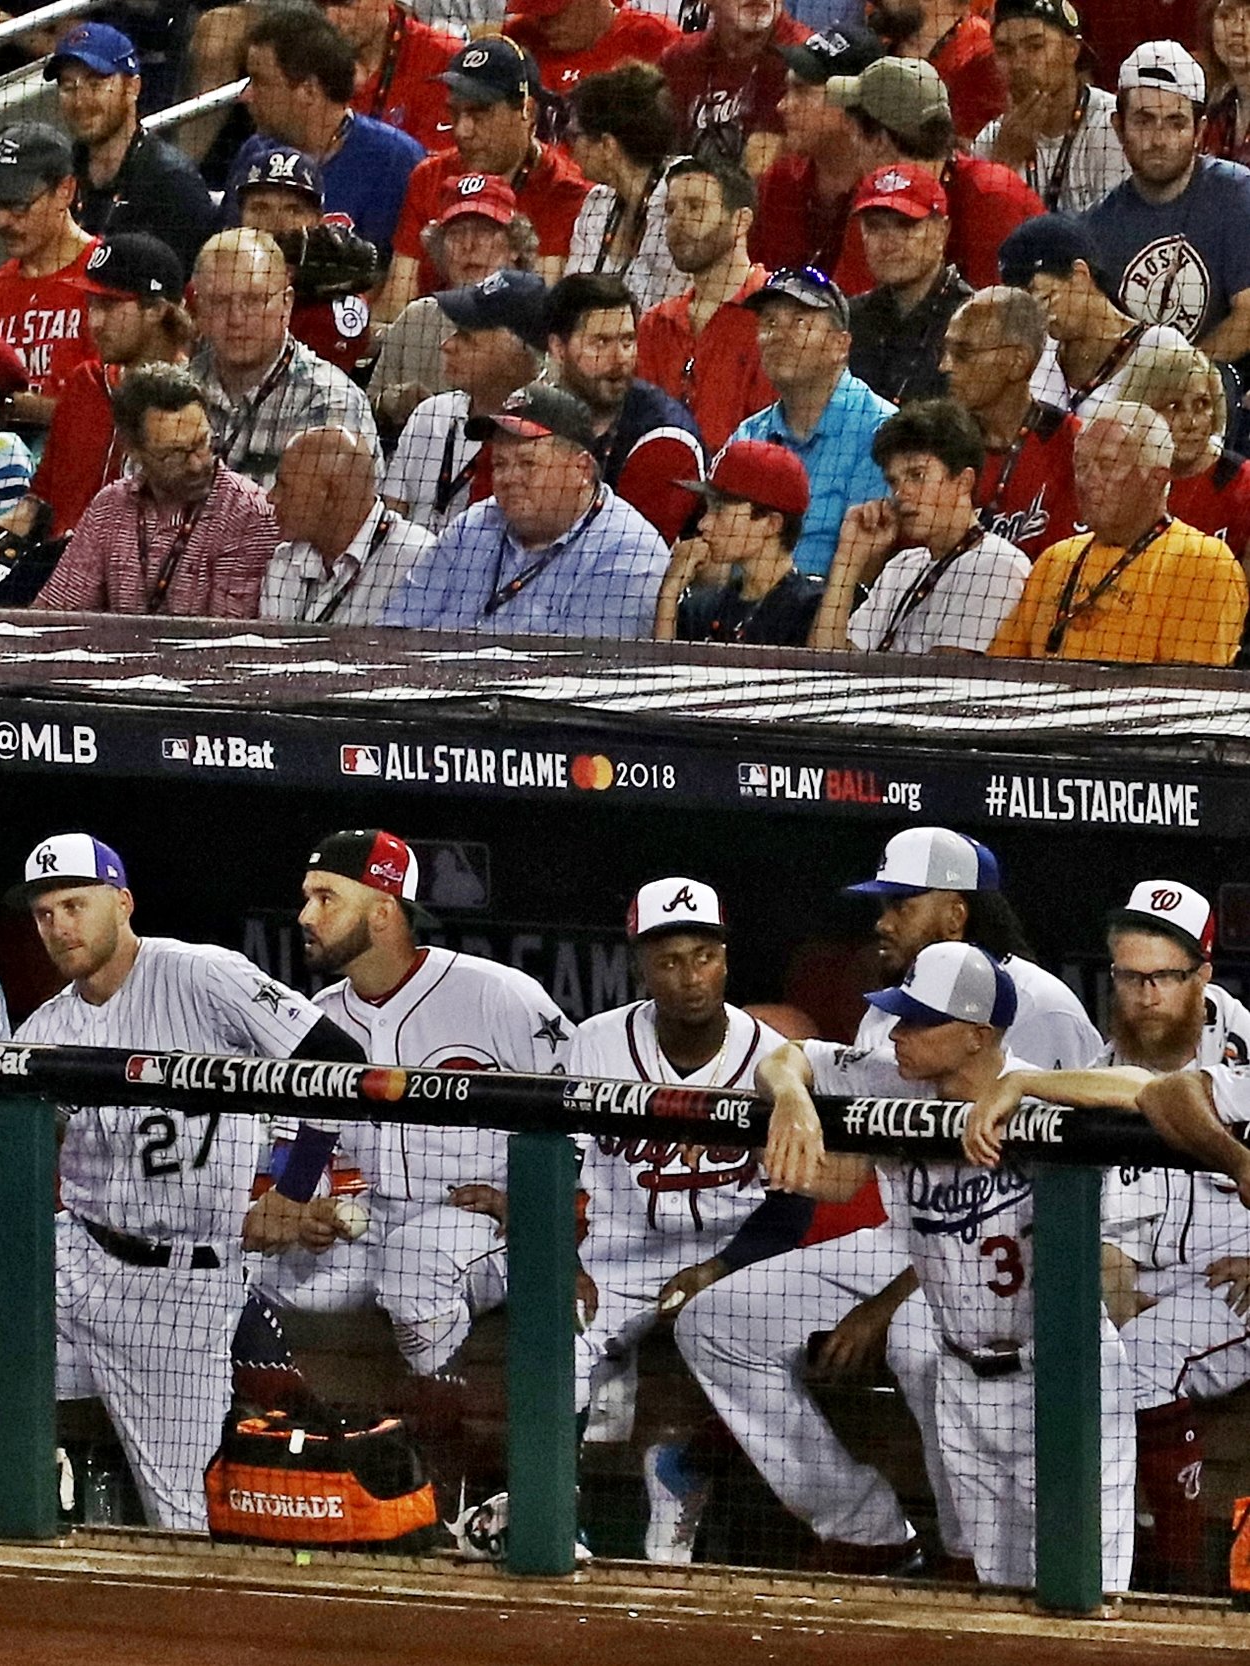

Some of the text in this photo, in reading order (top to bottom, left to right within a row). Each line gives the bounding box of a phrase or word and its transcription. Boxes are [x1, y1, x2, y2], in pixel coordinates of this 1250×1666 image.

[22, 308, 82, 345] STAR
[192, 735, 276, 770] At Bat
[384, 742, 676, 789] ALL STAR GAME 2018
[984, 774, 1200, 827] #ALLSTARGAME
[662, 885, 698, 913] A
[170, 1054, 470, 1101] ALL STAR GAME 2018
[138, 1110, 221, 1178] 27
[979, 1223, 1033, 1298] 3
[228, 1487, 345, 1519] GATORADE
